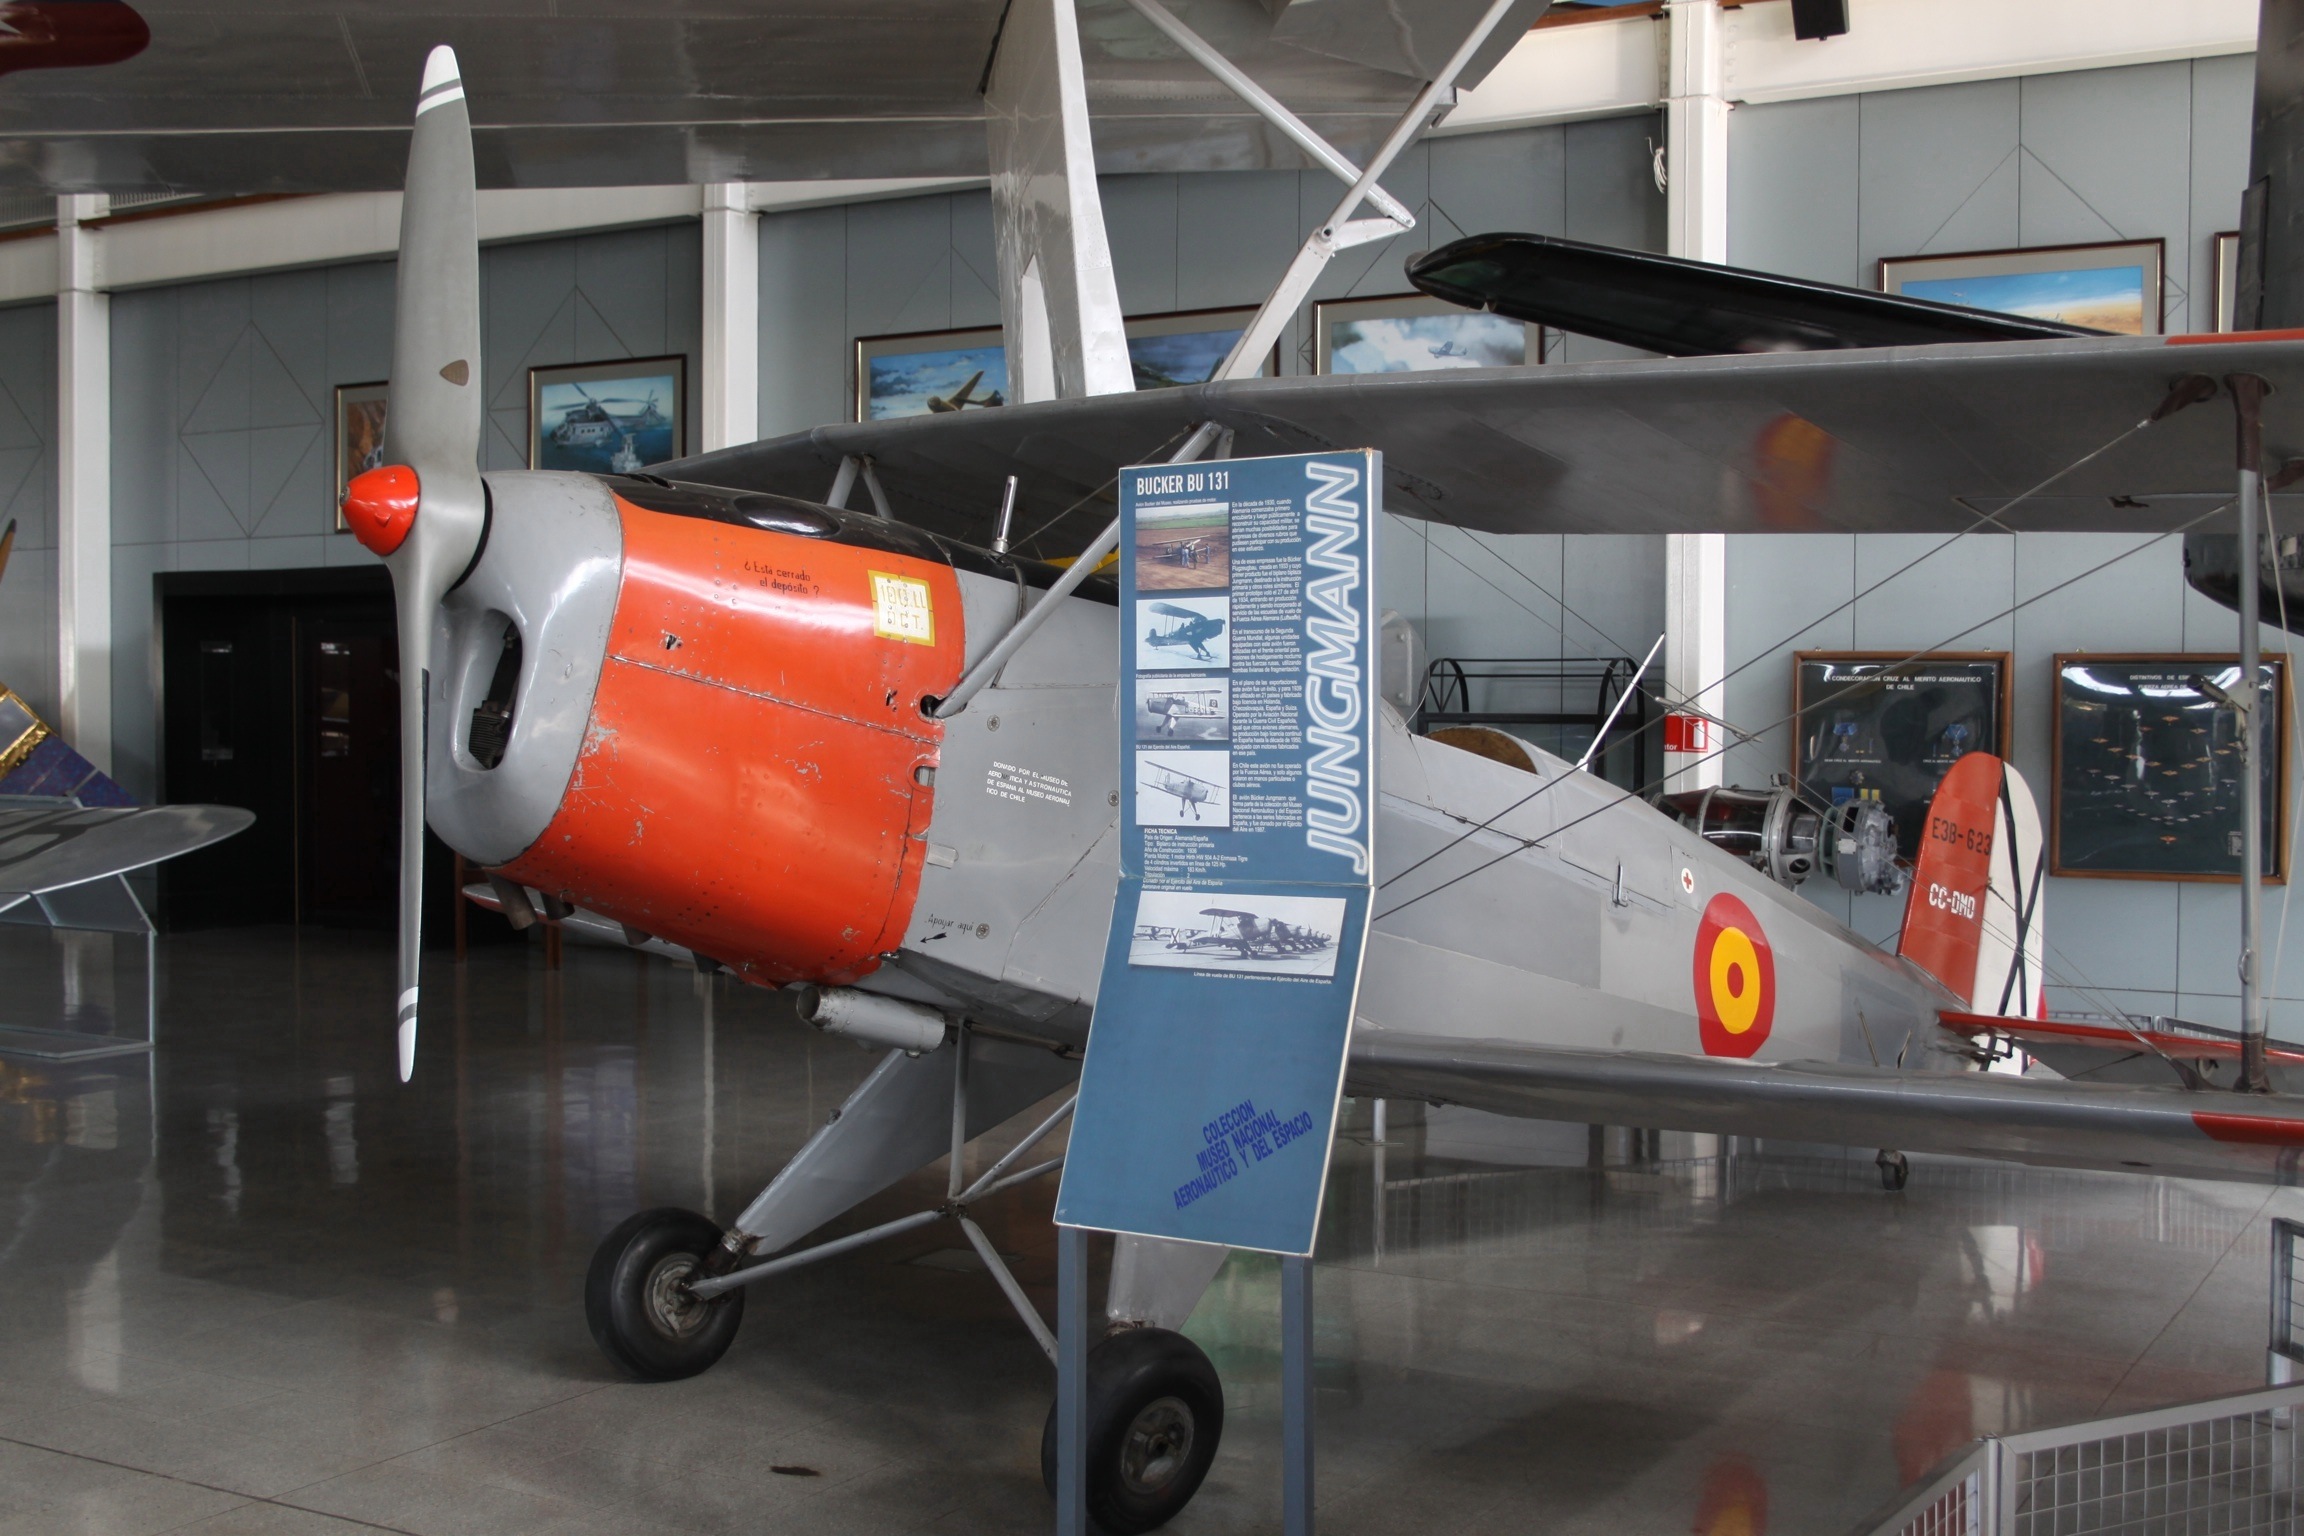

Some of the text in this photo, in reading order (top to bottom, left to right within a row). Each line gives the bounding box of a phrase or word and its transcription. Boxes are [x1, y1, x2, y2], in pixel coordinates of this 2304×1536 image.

[1137, 471, 1228, 495] BUCKER BU 131
[760, 578, 768, 587] el
[771, 580, 808, 595] depósito
[777, 569, 811, 582] cerrado
[1306, 462, 1368, 876] JUNGMANN
[1026, 789, 1044, 798] MUSEO
[1029, 781, 1072, 797] ASTRONAUTICA
[1929, 883, 1975, 919] CC-DMD
[1203, 1099, 1256, 1144] COLECCION
[1196, 1109, 1281, 1172] MUSEO NACIONAL
[1173, 1110, 1313, 1210] AERONAUTICO Y DEL ESPACIO
